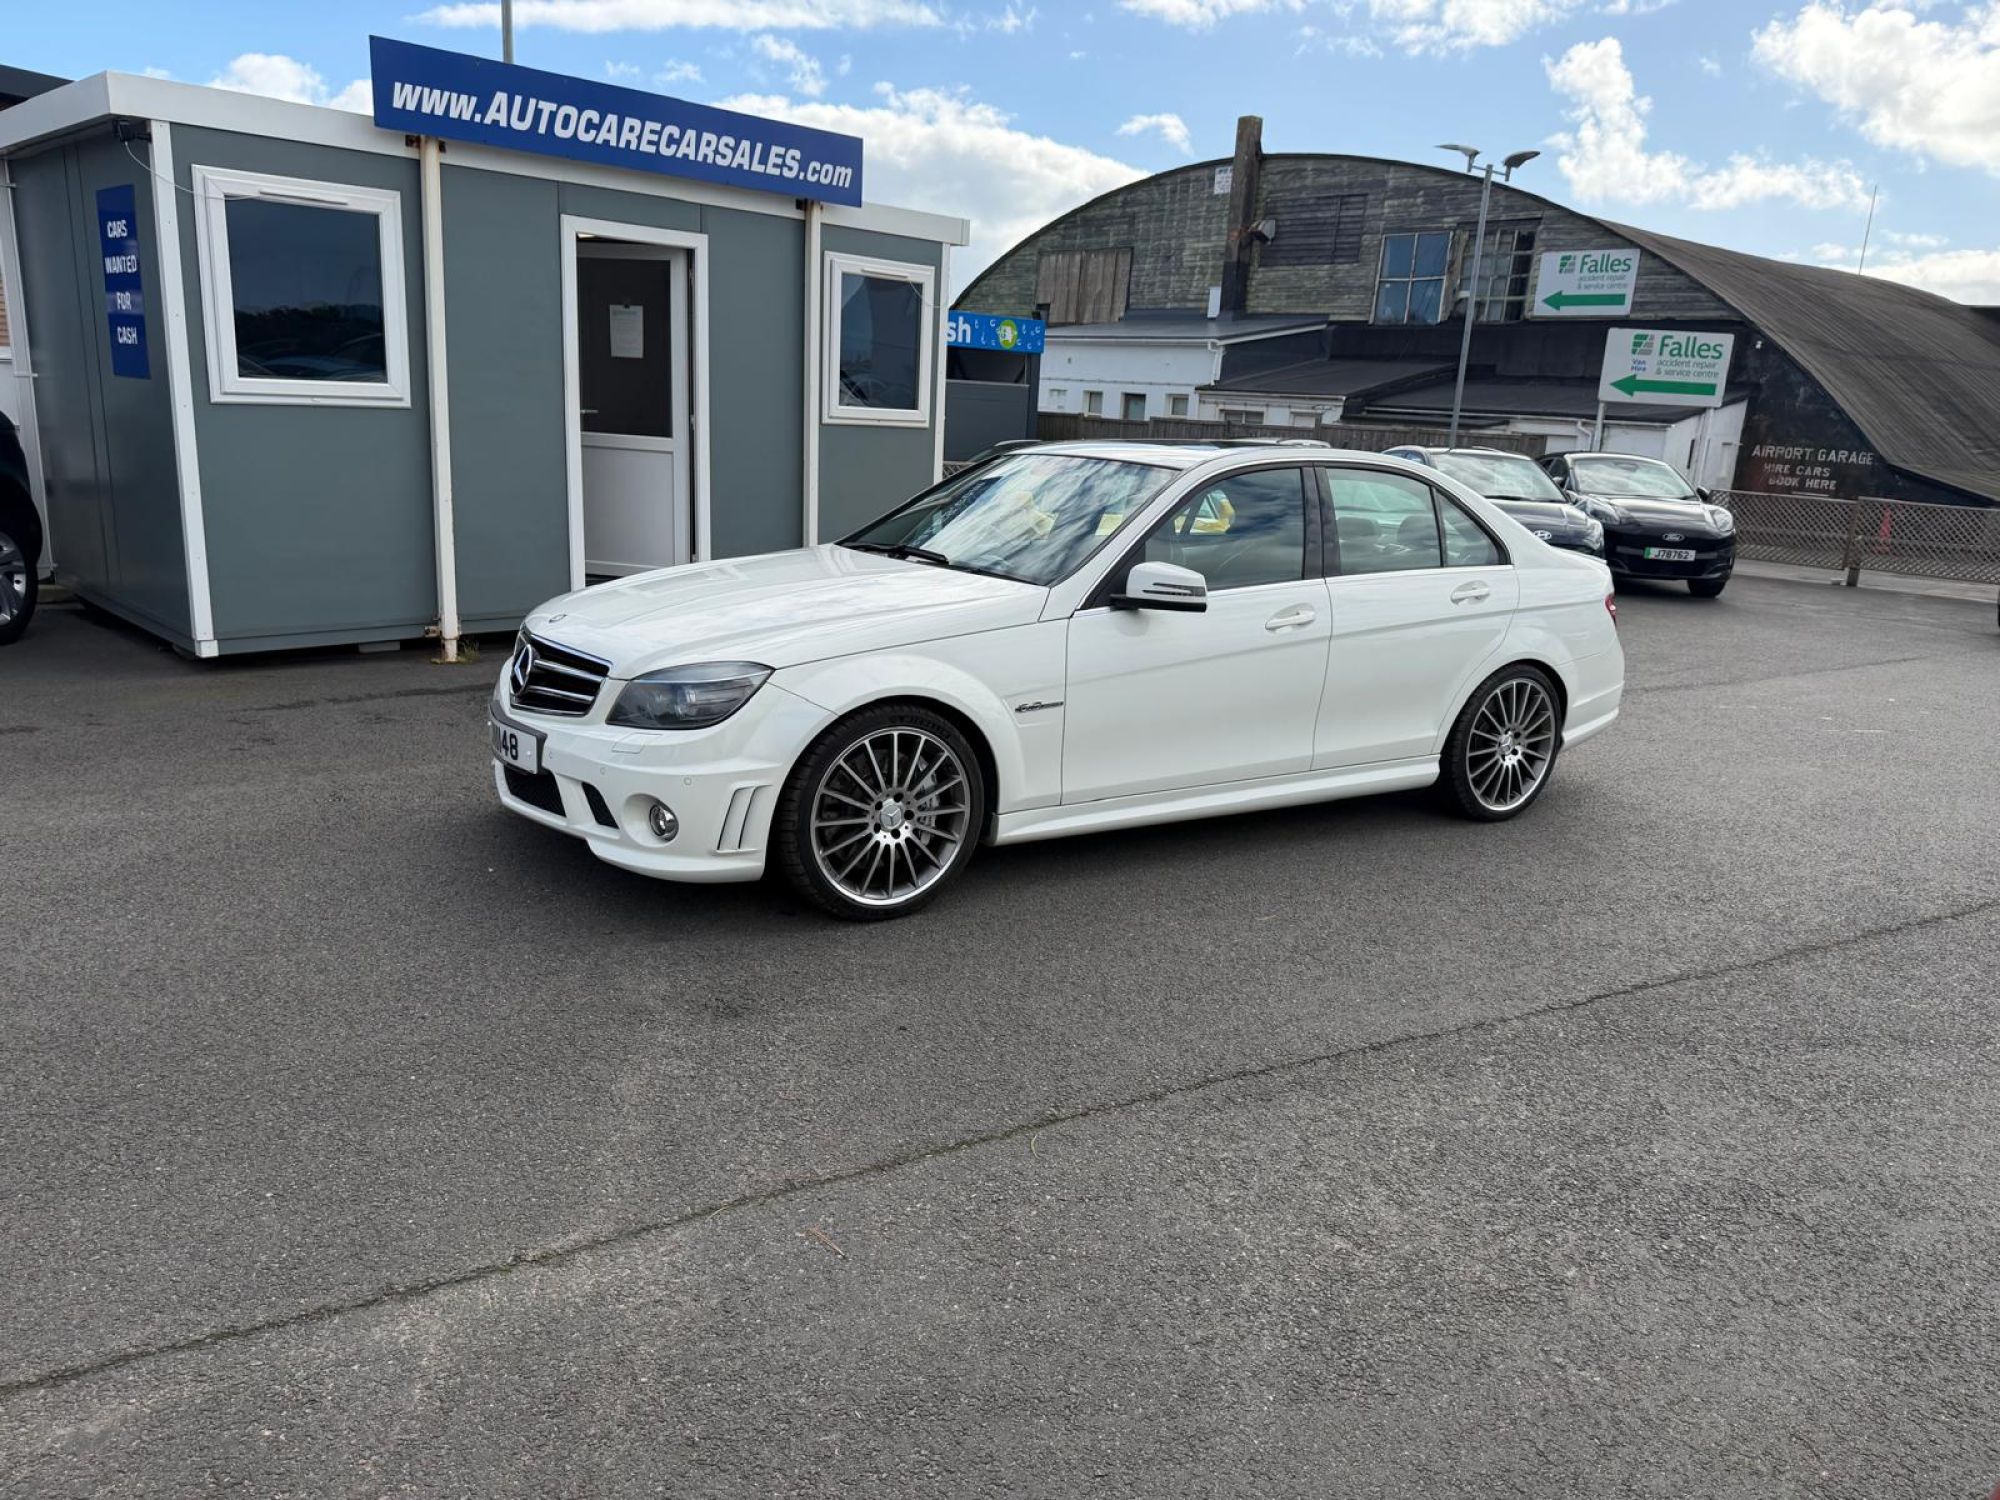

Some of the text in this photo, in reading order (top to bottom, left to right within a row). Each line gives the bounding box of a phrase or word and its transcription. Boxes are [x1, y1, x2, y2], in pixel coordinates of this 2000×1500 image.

[391, 81, 853, 189] www.AUTOCARECARSALES.com
[107, 220, 128, 237] CARS
[105, 255, 137, 274] WANTED
[1579, 253, 1632, 274] Falles
[116, 291, 132, 311] FOR
[117, 326, 138, 345] CASH
[1659, 335, 1724, 360] Falles
[1656, 358, 1717, 371] accident repair
[1663, 368, 1692, 376] service
[1693, 369, 1719, 378] centre
[1752, 445, 1874, 465] AIRPORT GARAGE
[1763, 462, 1831, 478] HIRE CARS
[1805, 479, 1837, 490] HERE
